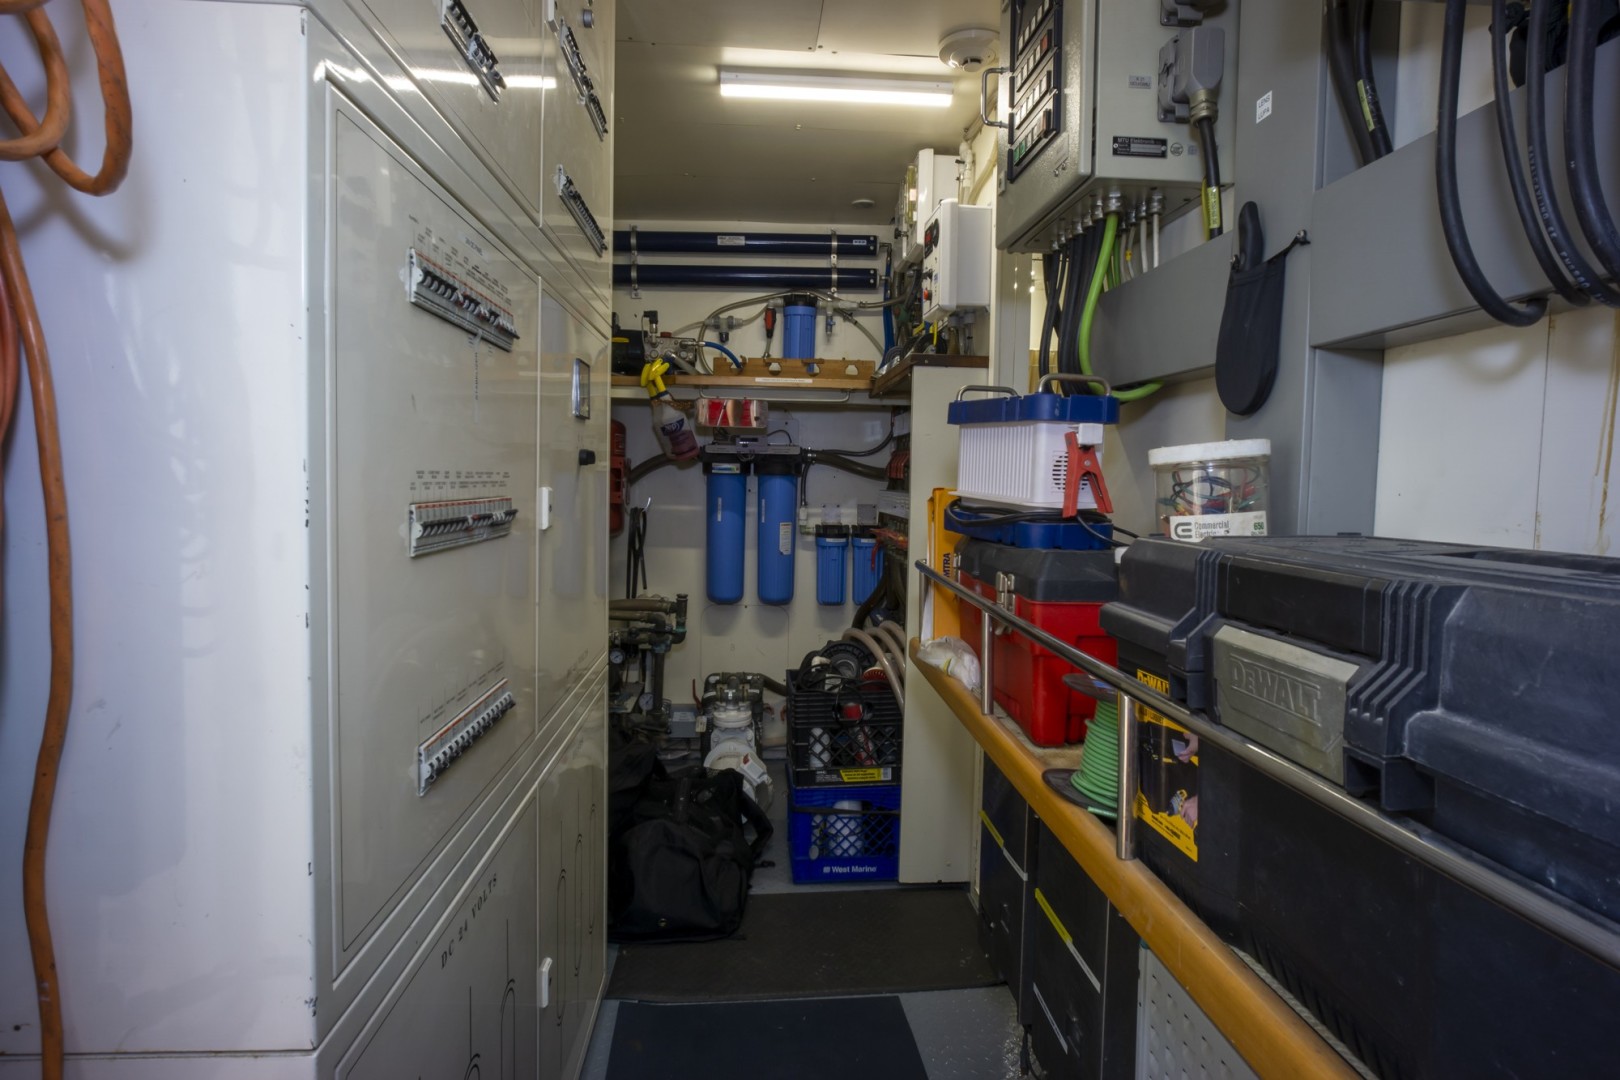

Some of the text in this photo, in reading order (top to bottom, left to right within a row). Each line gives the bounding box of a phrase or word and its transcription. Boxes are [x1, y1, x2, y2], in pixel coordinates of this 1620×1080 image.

[1258, 94, 1271, 109] LENS
[1194, 520, 1230, 530] Commercial
[1253, 521, 1265, 531] 650
[831, 865, 877, 873] West Marine
[441, 938, 455, 970] DC
[470, 872, 498, 919] VOLTS
